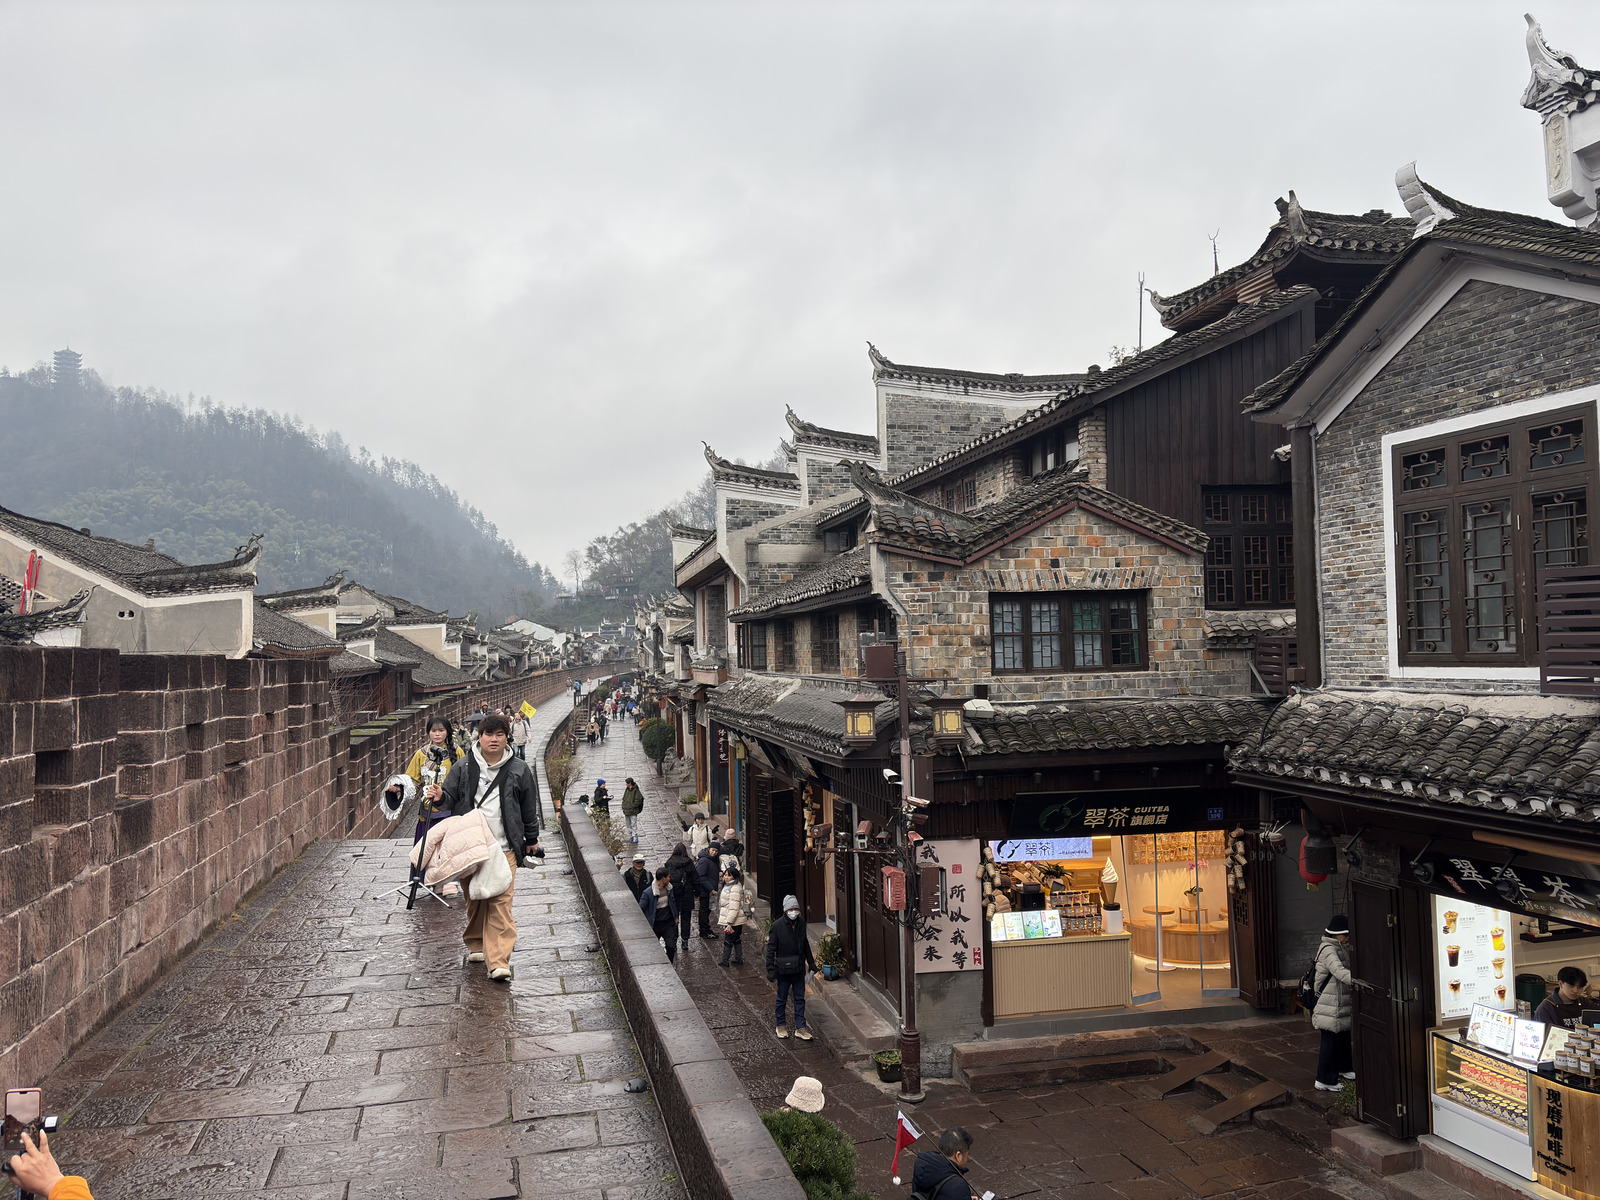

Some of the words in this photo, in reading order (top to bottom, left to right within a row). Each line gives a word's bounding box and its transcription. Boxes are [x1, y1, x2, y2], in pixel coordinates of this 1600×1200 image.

[1134, 805, 1170, 814] CUITEA
[1083, 806, 1130, 829] 翠茶
[1130, 814, 1168, 826] 旗舰店
[1025, 841, 1051, 856] 翠茶
[949, 884, 971, 969] 所以我等
[1546, 1088, 1564, 1158] 现磨咖啡
[1544, 1161, 1567, 1176] Coffee
